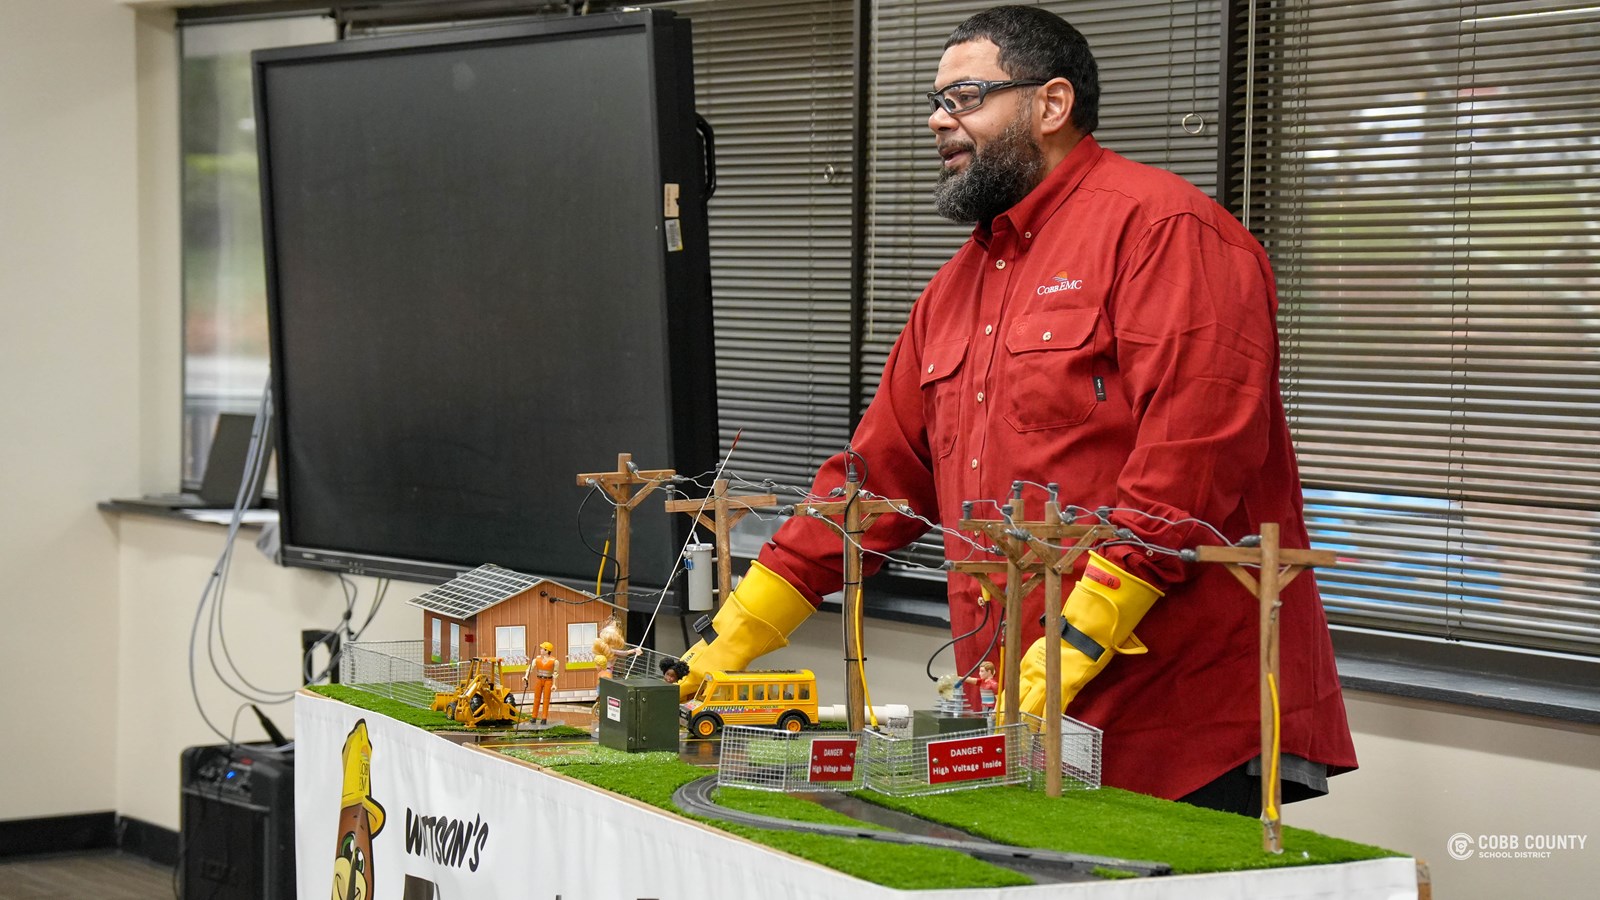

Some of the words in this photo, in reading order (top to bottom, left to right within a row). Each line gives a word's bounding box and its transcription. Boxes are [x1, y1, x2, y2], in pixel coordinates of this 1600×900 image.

[1037, 285, 1060, 296] COBB
[1060, 280, 1083, 291] EMC
[823, 748, 844, 757] DANGER
[950, 746, 984, 758] DANGER
[812, 764, 822, 774] High
[823, 764, 839, 774] Voltage
[840, 764, 852, 772] Inside
[932, 766, 950, 776] High
[952, 763, 979, 773] Voltage
[982, 760, 1002, 769] Inside
